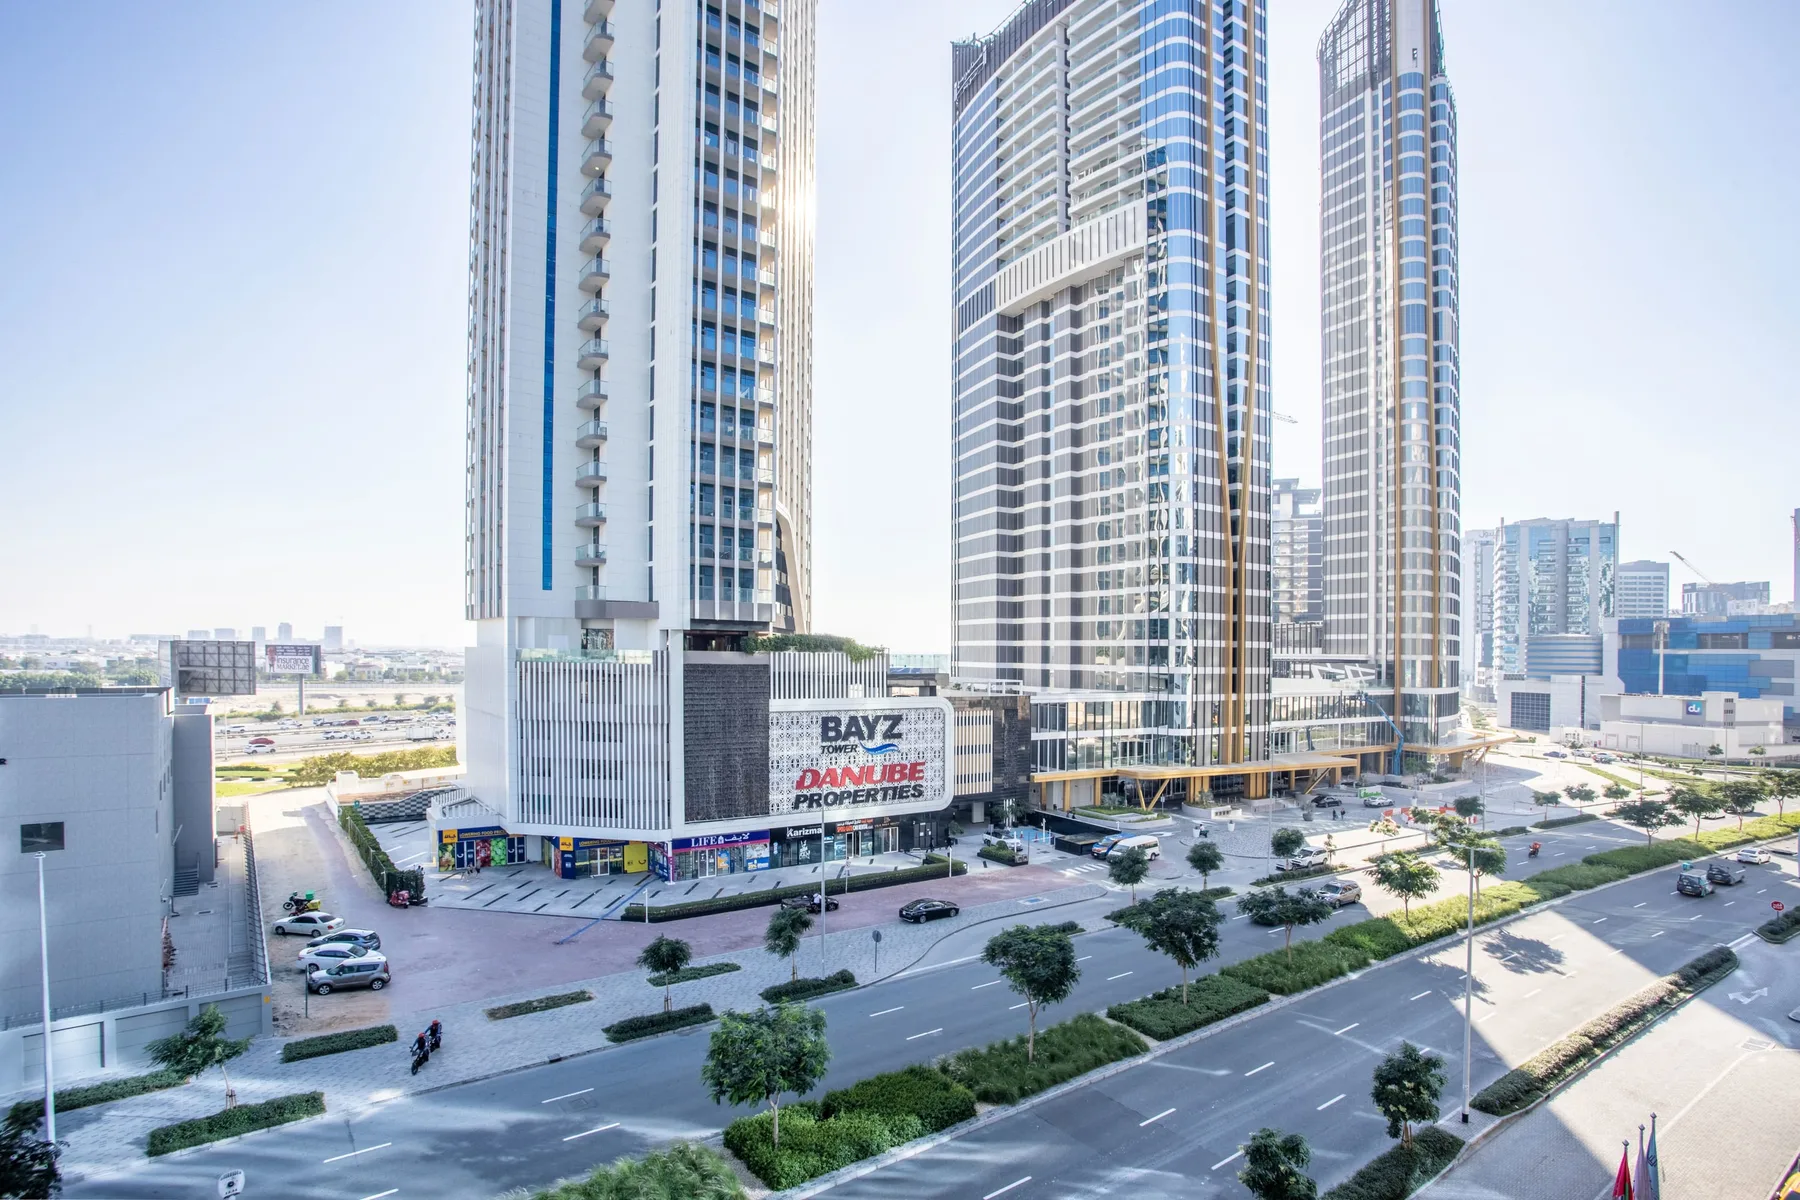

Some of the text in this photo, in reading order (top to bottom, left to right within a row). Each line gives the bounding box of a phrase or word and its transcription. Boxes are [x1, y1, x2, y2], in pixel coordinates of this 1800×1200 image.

[1688, 704, 1700, 712] du
[821, 714, 903, 742] BAYZ
[821, 744, 858, 755] TOWER
[795, 761, 925, 790] DANUBE
[793, 783, 924, 810] PROPERTIES
[786, 826, 822, 838] Karizma
[691, 836, 717, 847] LIFE
